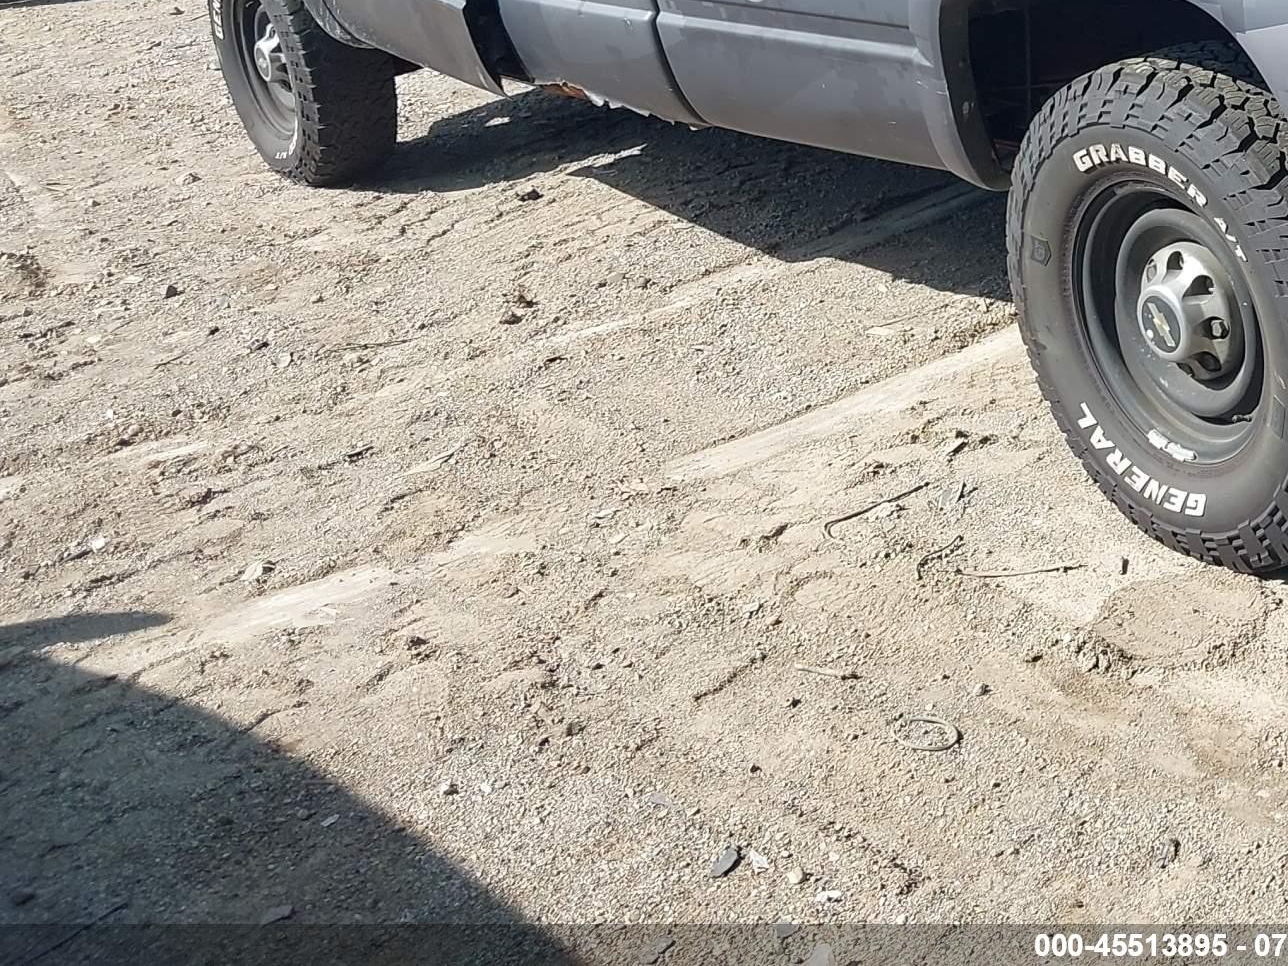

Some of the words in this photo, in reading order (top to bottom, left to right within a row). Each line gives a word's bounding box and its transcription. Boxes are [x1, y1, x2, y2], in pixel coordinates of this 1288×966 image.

[1073, 142, 1210, 208] GRABBER
[1212, 216, 1248, 263] A/T
[1075, 401, 1208, 518] GENERAL
